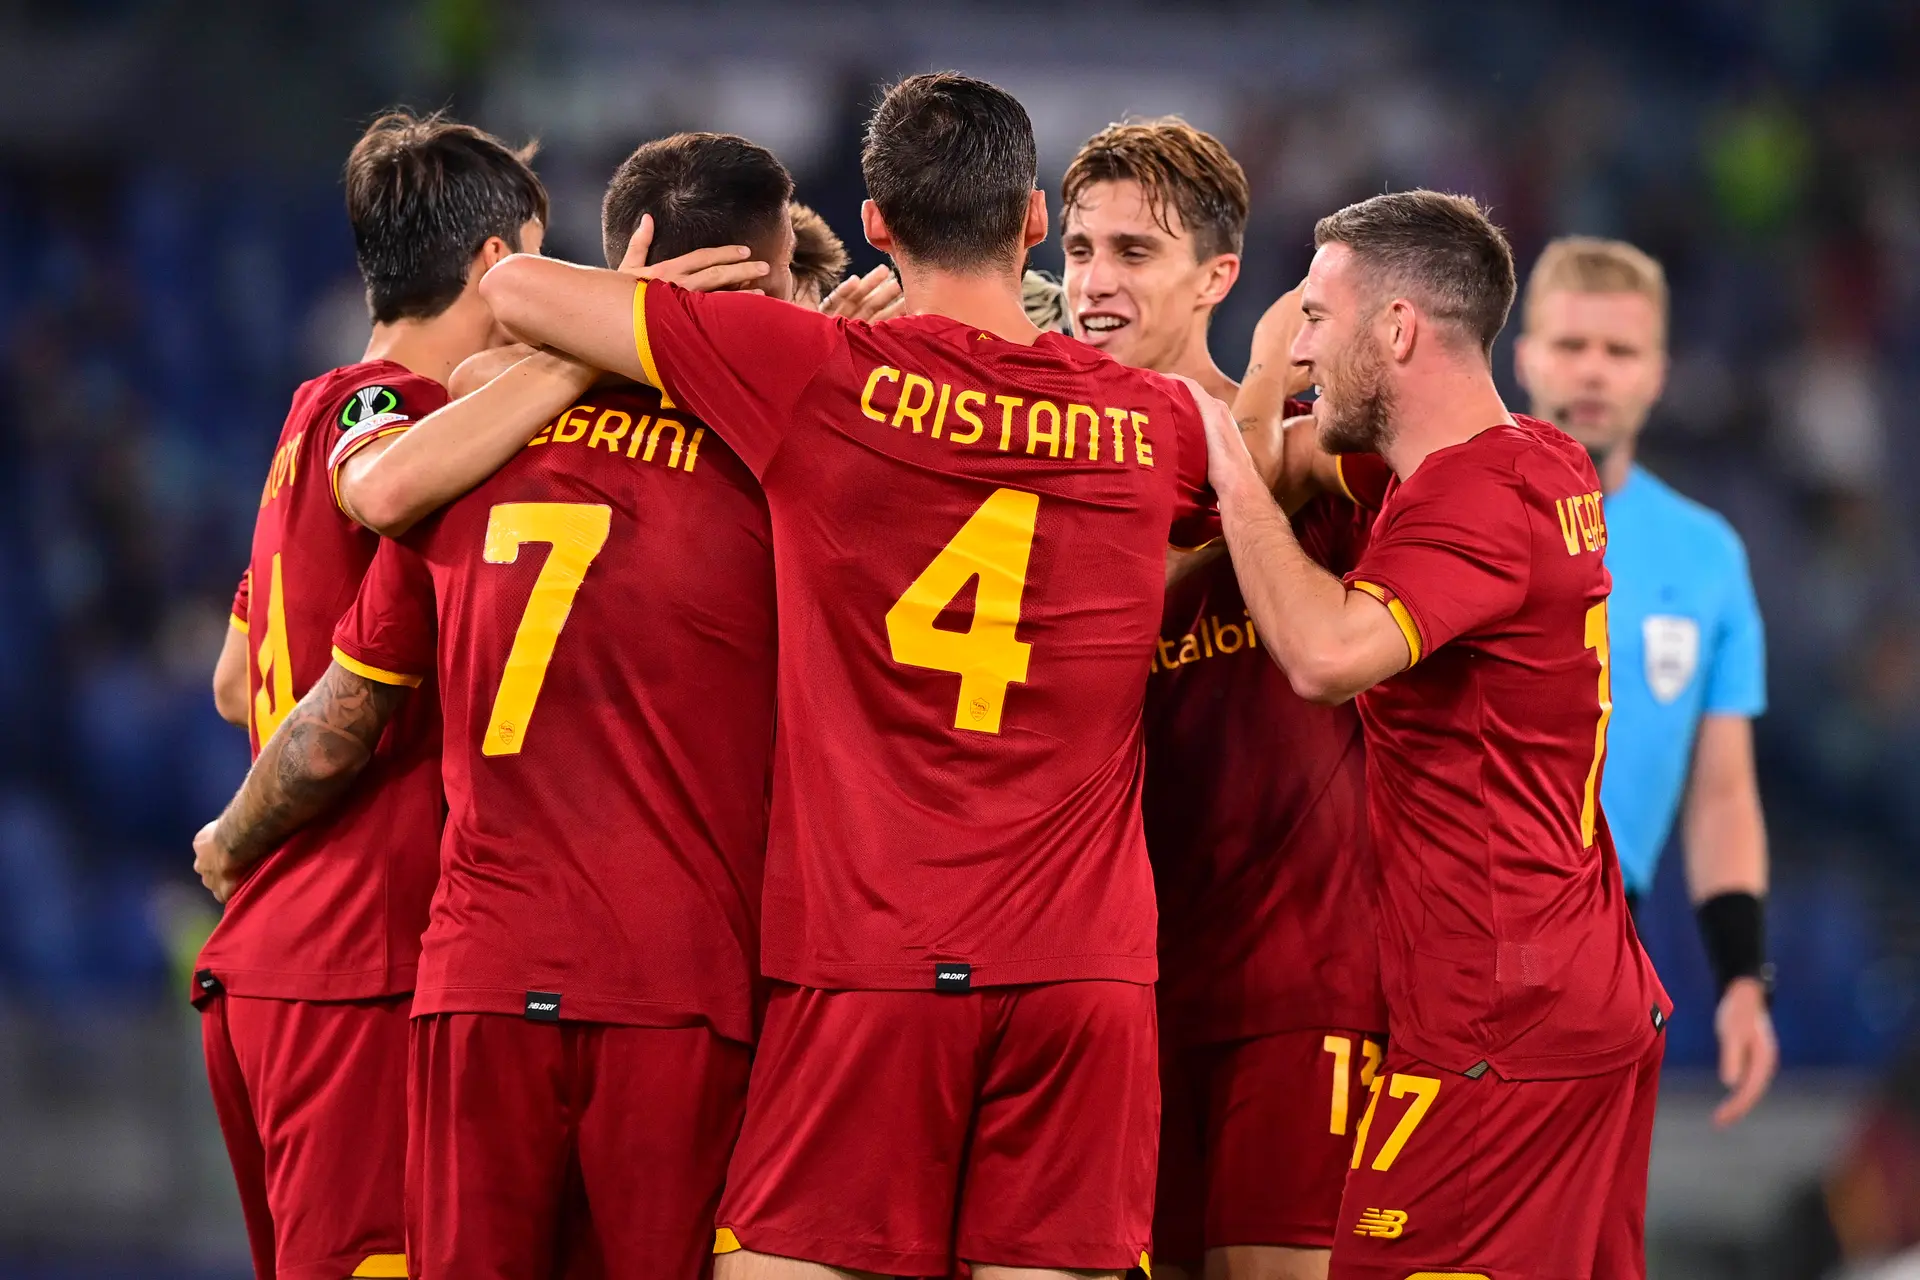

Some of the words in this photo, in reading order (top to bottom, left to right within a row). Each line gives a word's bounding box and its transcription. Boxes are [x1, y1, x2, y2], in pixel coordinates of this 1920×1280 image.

[860, 364, 1155, 467] CRISTANTE
[248, 551, 297, 750] 4
[482, 502, 612, 756] 7
[885, 487, 1039, 734] 4
[1350, 1072, 1442, 1172] 17
